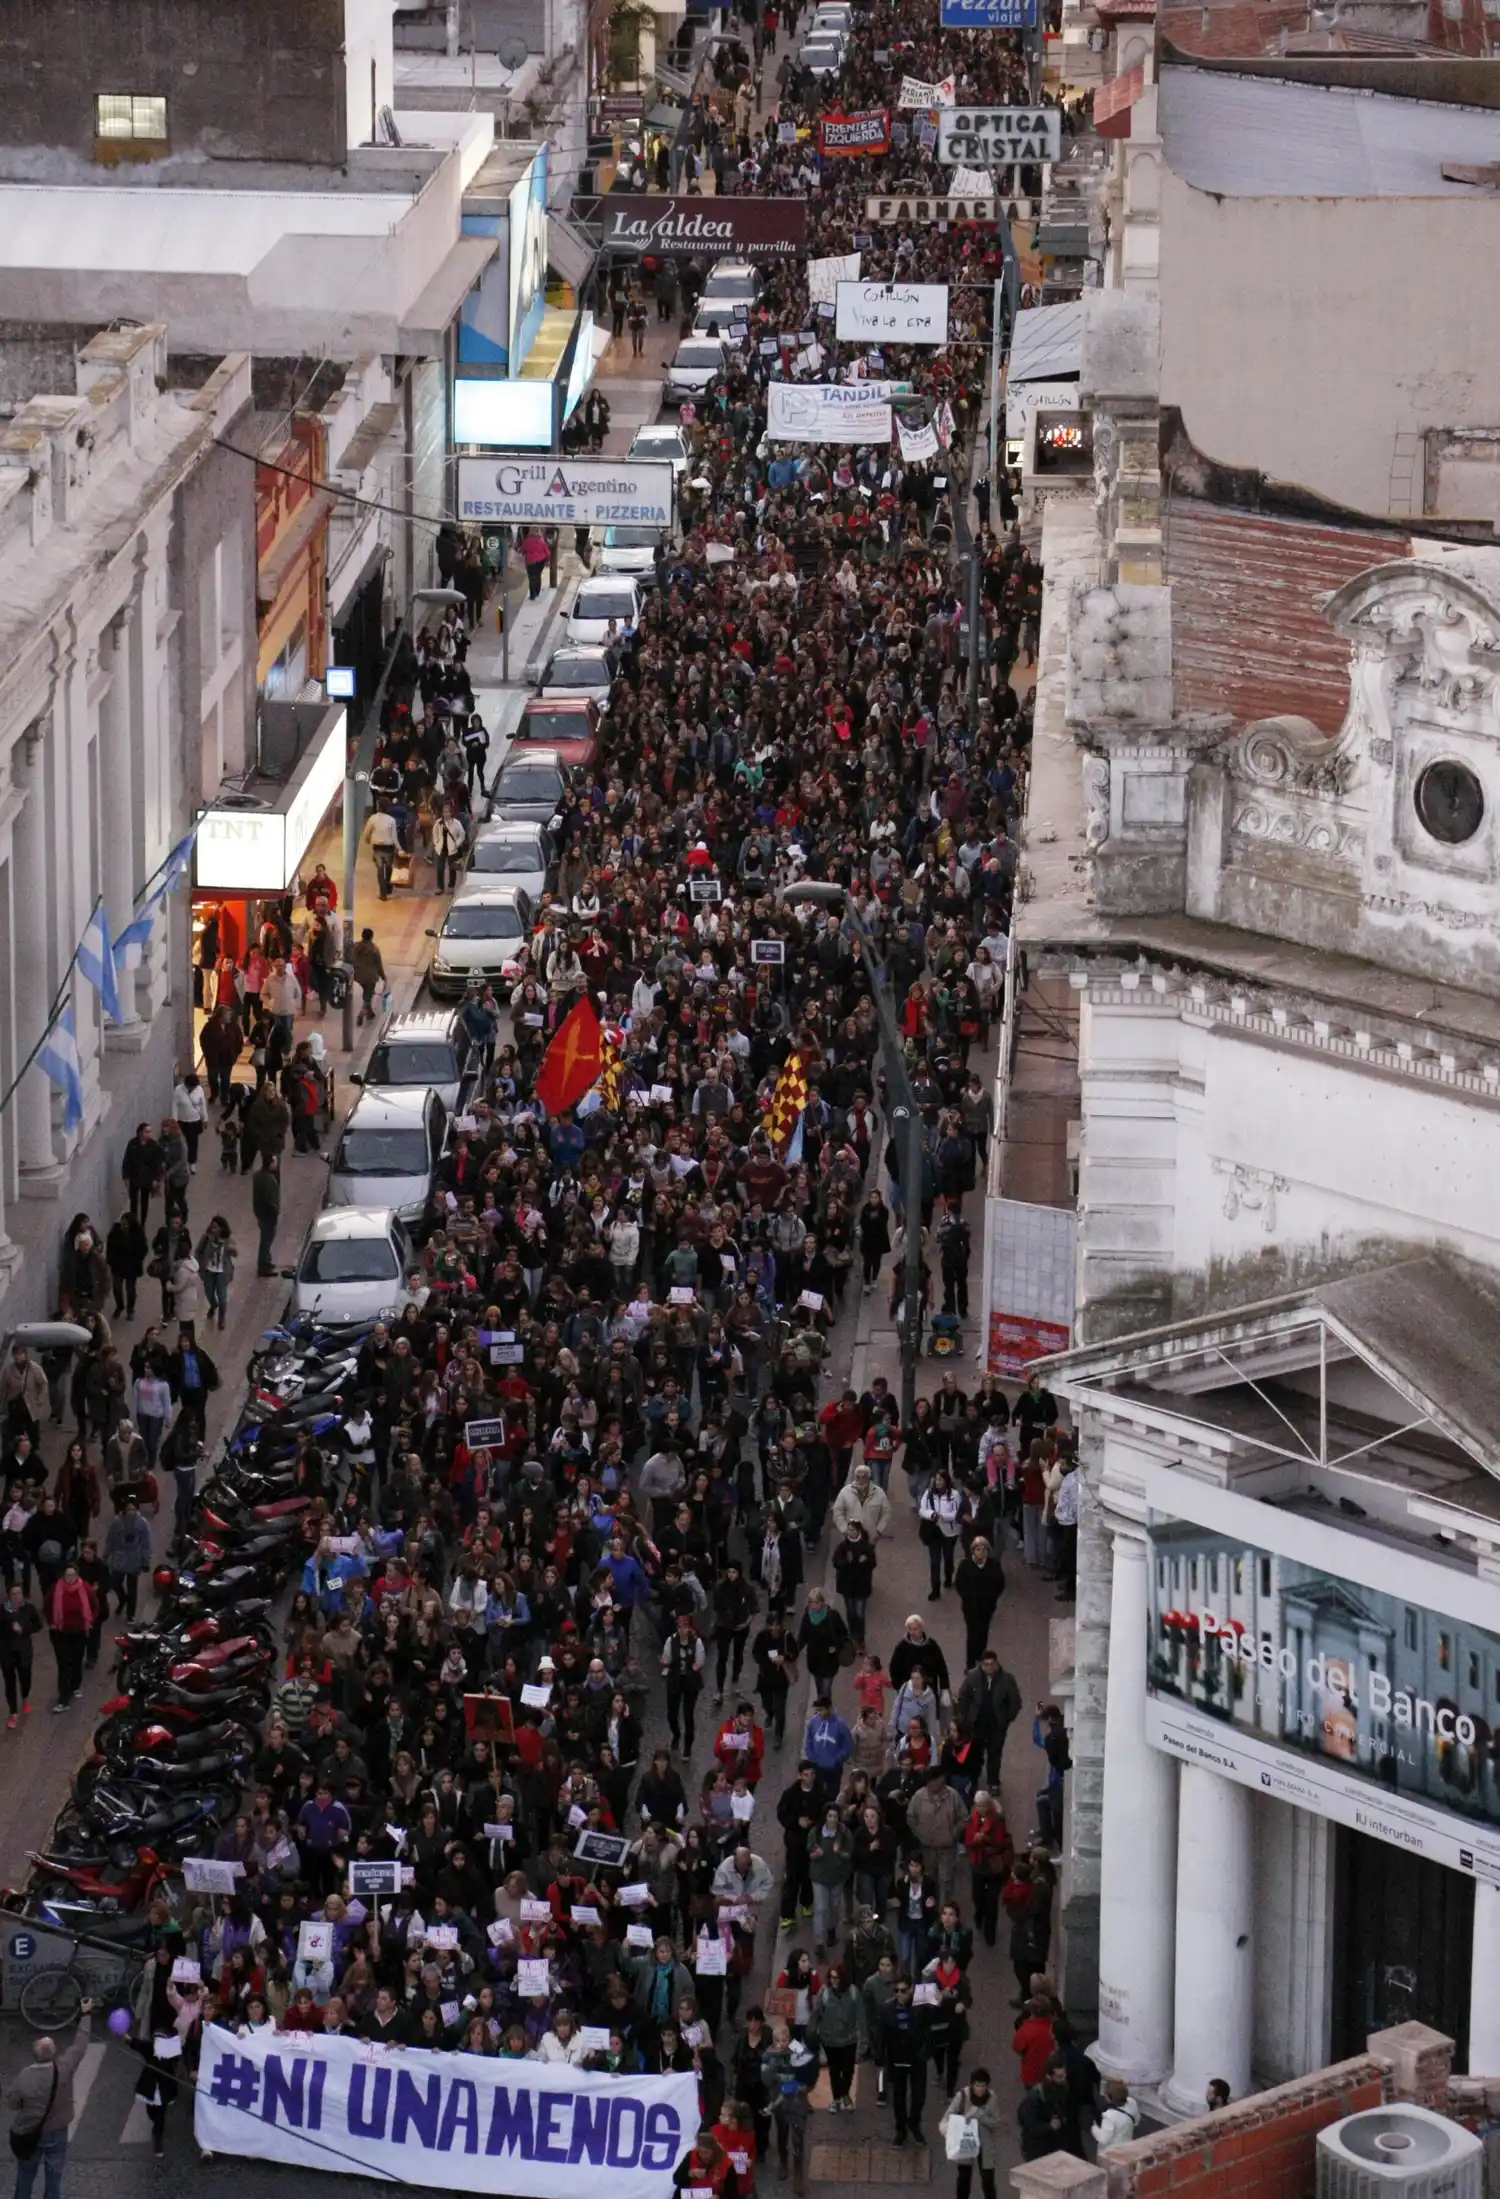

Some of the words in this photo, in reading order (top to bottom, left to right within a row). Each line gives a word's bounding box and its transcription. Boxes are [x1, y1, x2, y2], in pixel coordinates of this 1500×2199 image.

[825, 120, 867, 134] FRENTE
[955, 114, 1049, 133] OPTICA
[825, 127, 884, 144] IZQUIERDA
[948, 138, 1051, 159] CRISTAL
[879, 201, 1019, 218] FARMACIA
[611, 212, 648, 236] La
[657, 213, 734, 237] aldea
[660, 238, 731, 250] Restaurant
[735, 242, 744, 252] y
[747, 240, 796, 253] parrilla
[820, 386, 886, 403] TANDIL
[495, 466, 546, 496] Grill
[544, 466, 638, 498] Argentino
[463, 501, 575, 518] RESTAURANTE
[596, 504, 666, 521] PIZZERIA
[205, 819, 264, 841] TNT
[1199, 1605, 1298, 1679] Paseo
[1306, 1652, 1359, 1709] del
[1369, 1670, 1477, 1746] Banco
[1163, 1734, 1185, 1749] Paseo
[1186, 1743, 1198, 1755] del
[1199, 1748, 1222, 1765] Banco
[1369, 1820, 1424, 1849] interurban
[15, 1938, 29, 1955] E
[210, 2052, 328, 2131] #NI
[347, 2062, 479, 2155] UNA
[484, 2085, 681, 2171] MENOS
